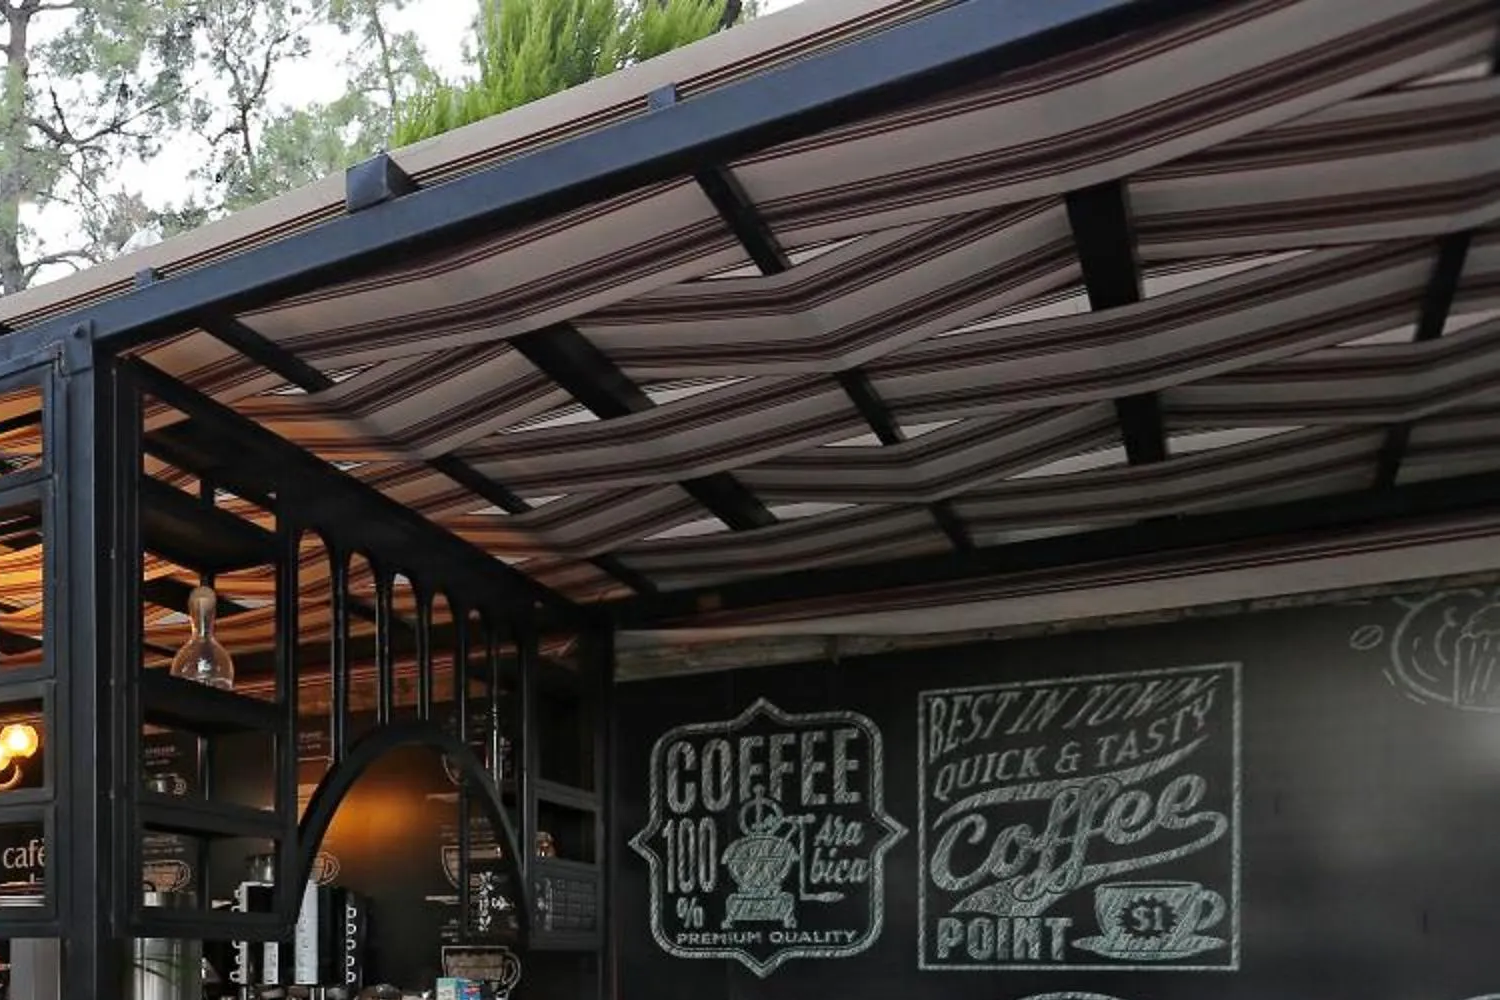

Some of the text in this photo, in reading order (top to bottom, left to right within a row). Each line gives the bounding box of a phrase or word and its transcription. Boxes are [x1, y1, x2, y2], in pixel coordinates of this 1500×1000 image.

[929, 674, 1220, 764] BEST IN TOWN
[933, 685, 1216, 801] QUICK & TASTY
[666, 728, 863, 814] COFFEE
[813, 813, 865, 847] Ara
[930, 773, 1228, 903] Coffee
[661, 817, 718, 894] 100
[810, 847, 870, 885] bica
[676, 896, 704, 929] %
[1130, 905, 1164, 932] $1
[676, 929, 858, 946] PREMIUM QUALITY
[936, 917, 1073, 961] POINT
